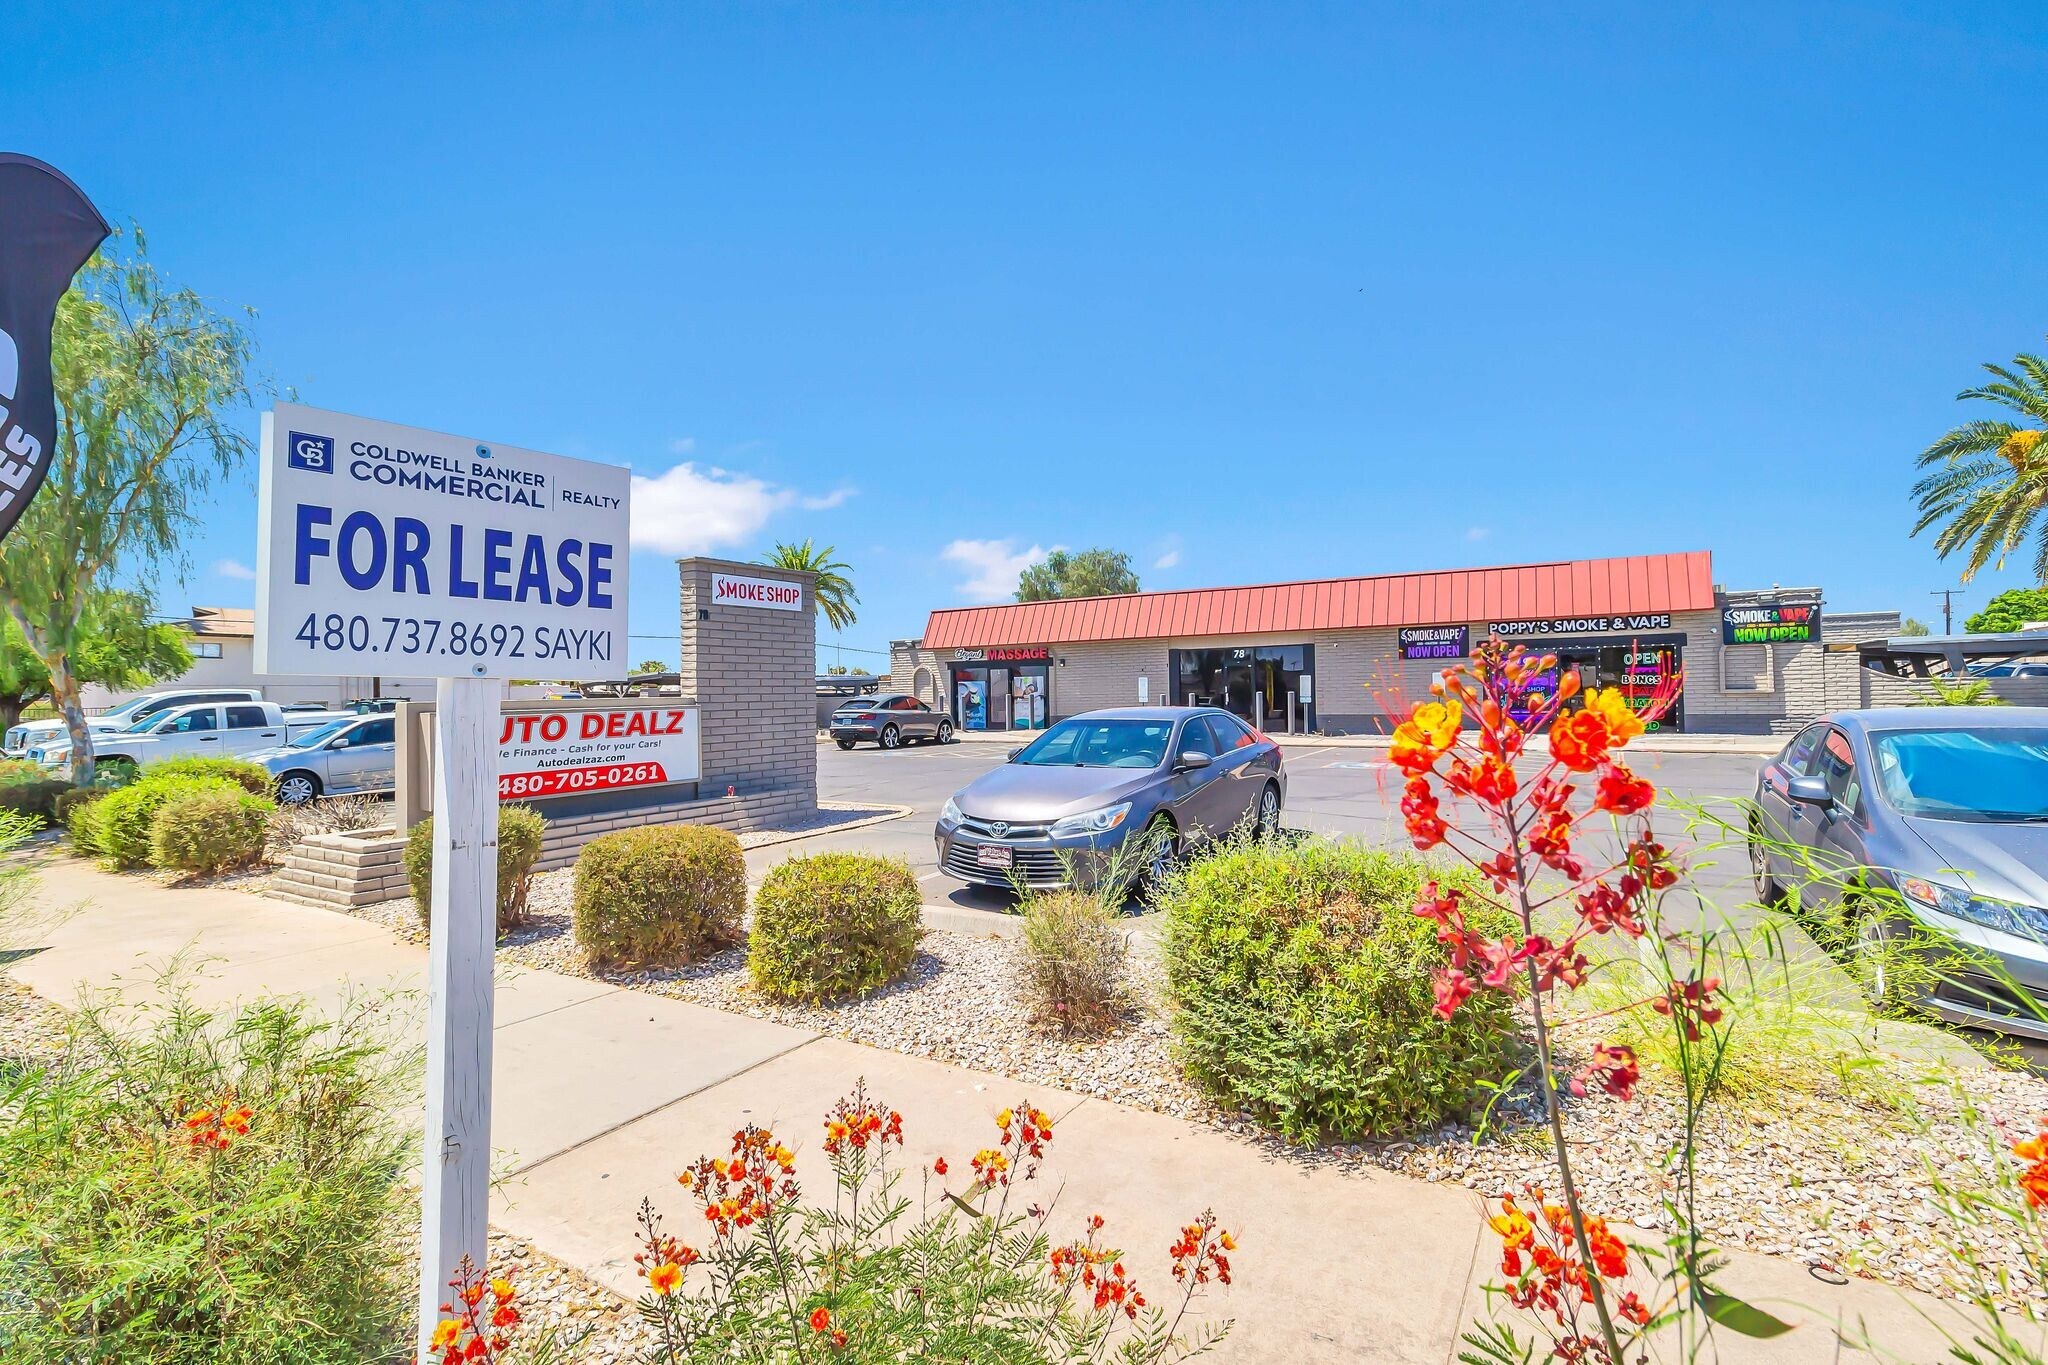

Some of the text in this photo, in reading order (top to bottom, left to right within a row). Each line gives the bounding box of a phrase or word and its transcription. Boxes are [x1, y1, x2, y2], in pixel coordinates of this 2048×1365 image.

[350, 441, 545, 488] COLDWELL BANKER
[350, 460, 545, 509] COMMERCIAL
[562, 490, 620, 510] REALTY
[294, 503, 613, 609] FOR LEASE
[716, 577, 799, 604] SMOKE SHOP
[1489, 615, 1670, 634] POPPY'S SMOKE & VAPE
[1732, 609, 1771, 623] SMOKE
[295, 612, 611, 661] 480.737.8692 SAYKI
[1734, 626, 1809, 642] NOW OPEN
[986, 648, 1048, 660] MASSAGE
[1233, 650, 1245, 658] 78
[1407, 645, 1460, 658] NOW OPEN
[1623, 652, 1661, 665] OPEN
[499, 710, 685, 745] UTO DEALZ
[513, 748, 557, 758] Finance
[568, 744, 593, 753] Cash
[596, 743, 611, 751] for
[614, 742, 635, 751] your
[638, 740, 662, 748] Cars!
[536, 754, 626, 768] Autodealzaz.com
[498, 765, 659, 795] 480-705-0261
